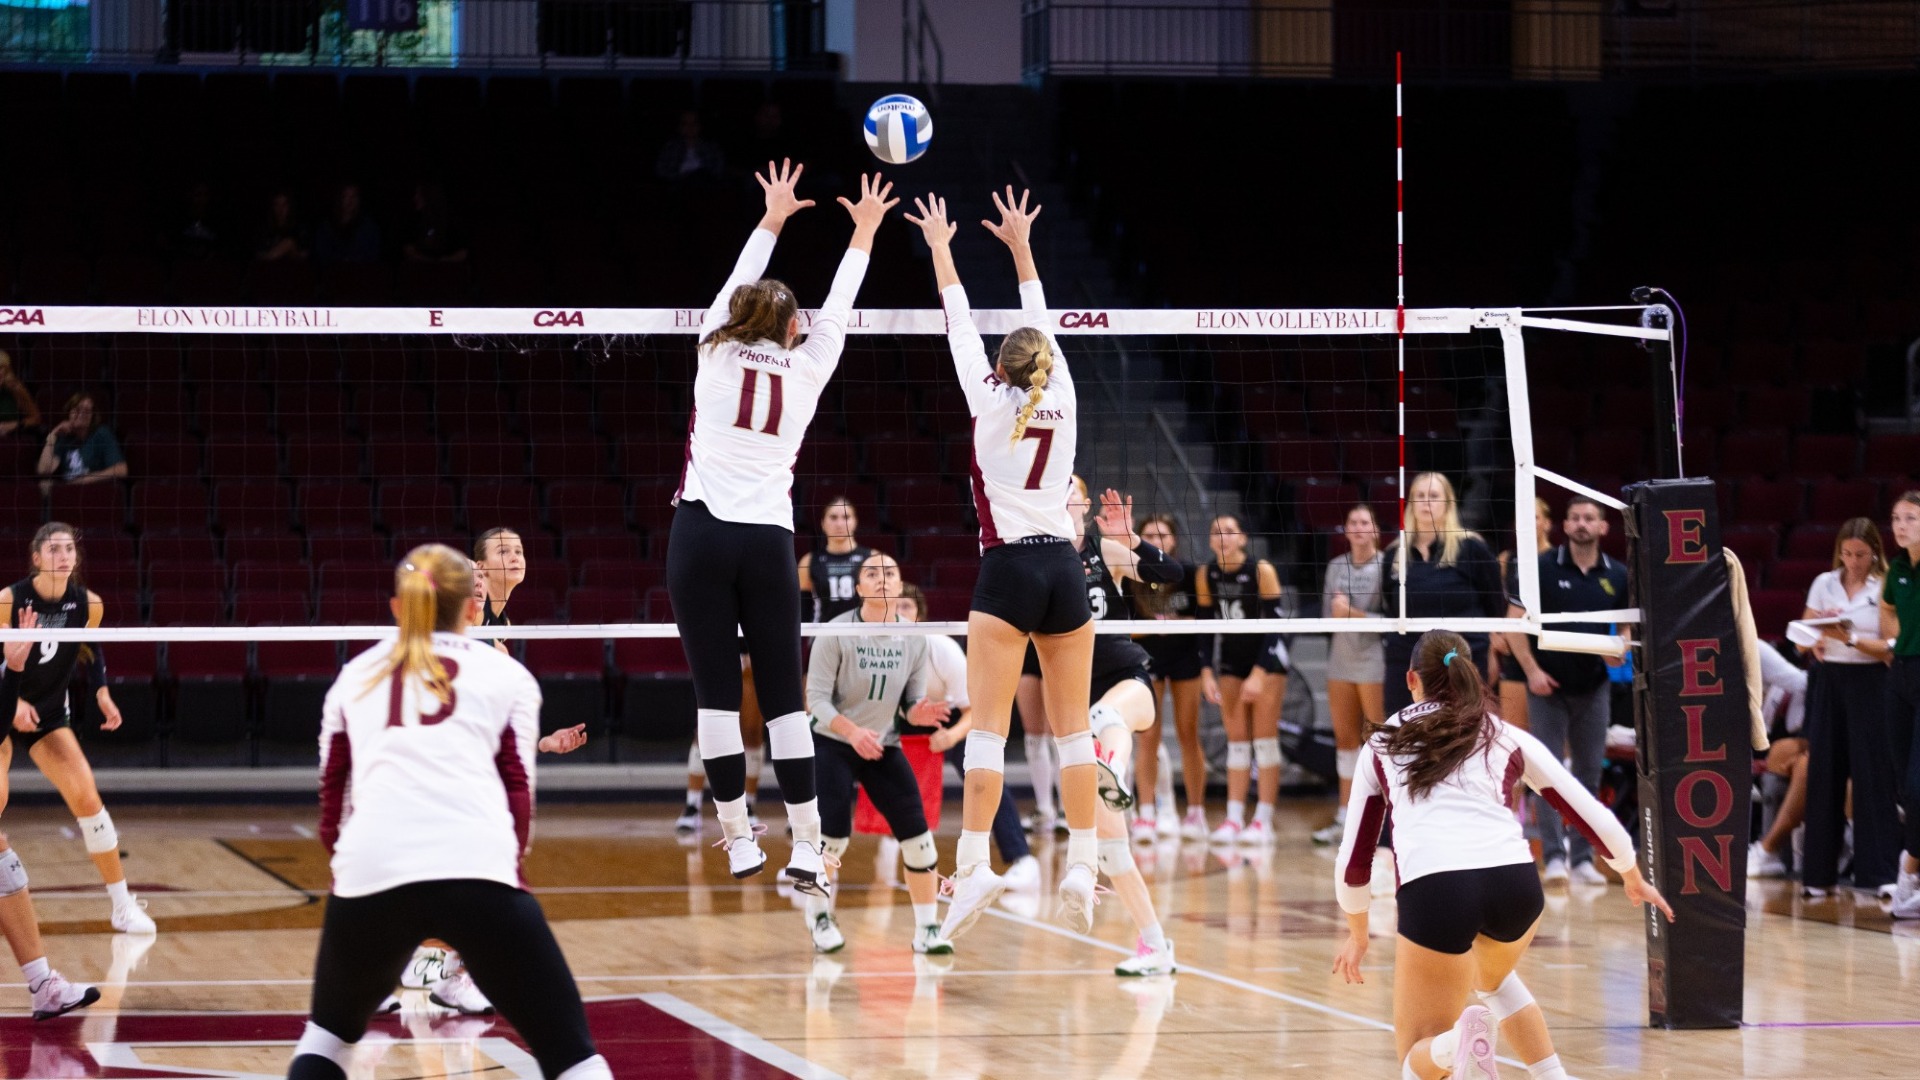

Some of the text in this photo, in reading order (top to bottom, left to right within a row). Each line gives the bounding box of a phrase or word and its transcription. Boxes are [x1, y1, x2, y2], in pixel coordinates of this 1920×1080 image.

[0, 309, 45, 325] CAA
[137, 309, 338, 328] ELON VOLLEYBALL
[429, 311, 444, 327] E
[533, 311, 585, 327] CAA
[1059, 312, 1110, 328] CAA
[1196, 312, 1386, 328] ELON VOLLEYBALL
[733, 367, 783, 435] 11
[1021, 427, 1054, 489] 7
[1662, 509, 1709, 565] E
[856, 646, 902, 657] WILLIAM
[868, 674, 887, 701] 11
[1674, 638, 1734, 894] ELON
[1644, 806, 1659, 938] sports imorts
